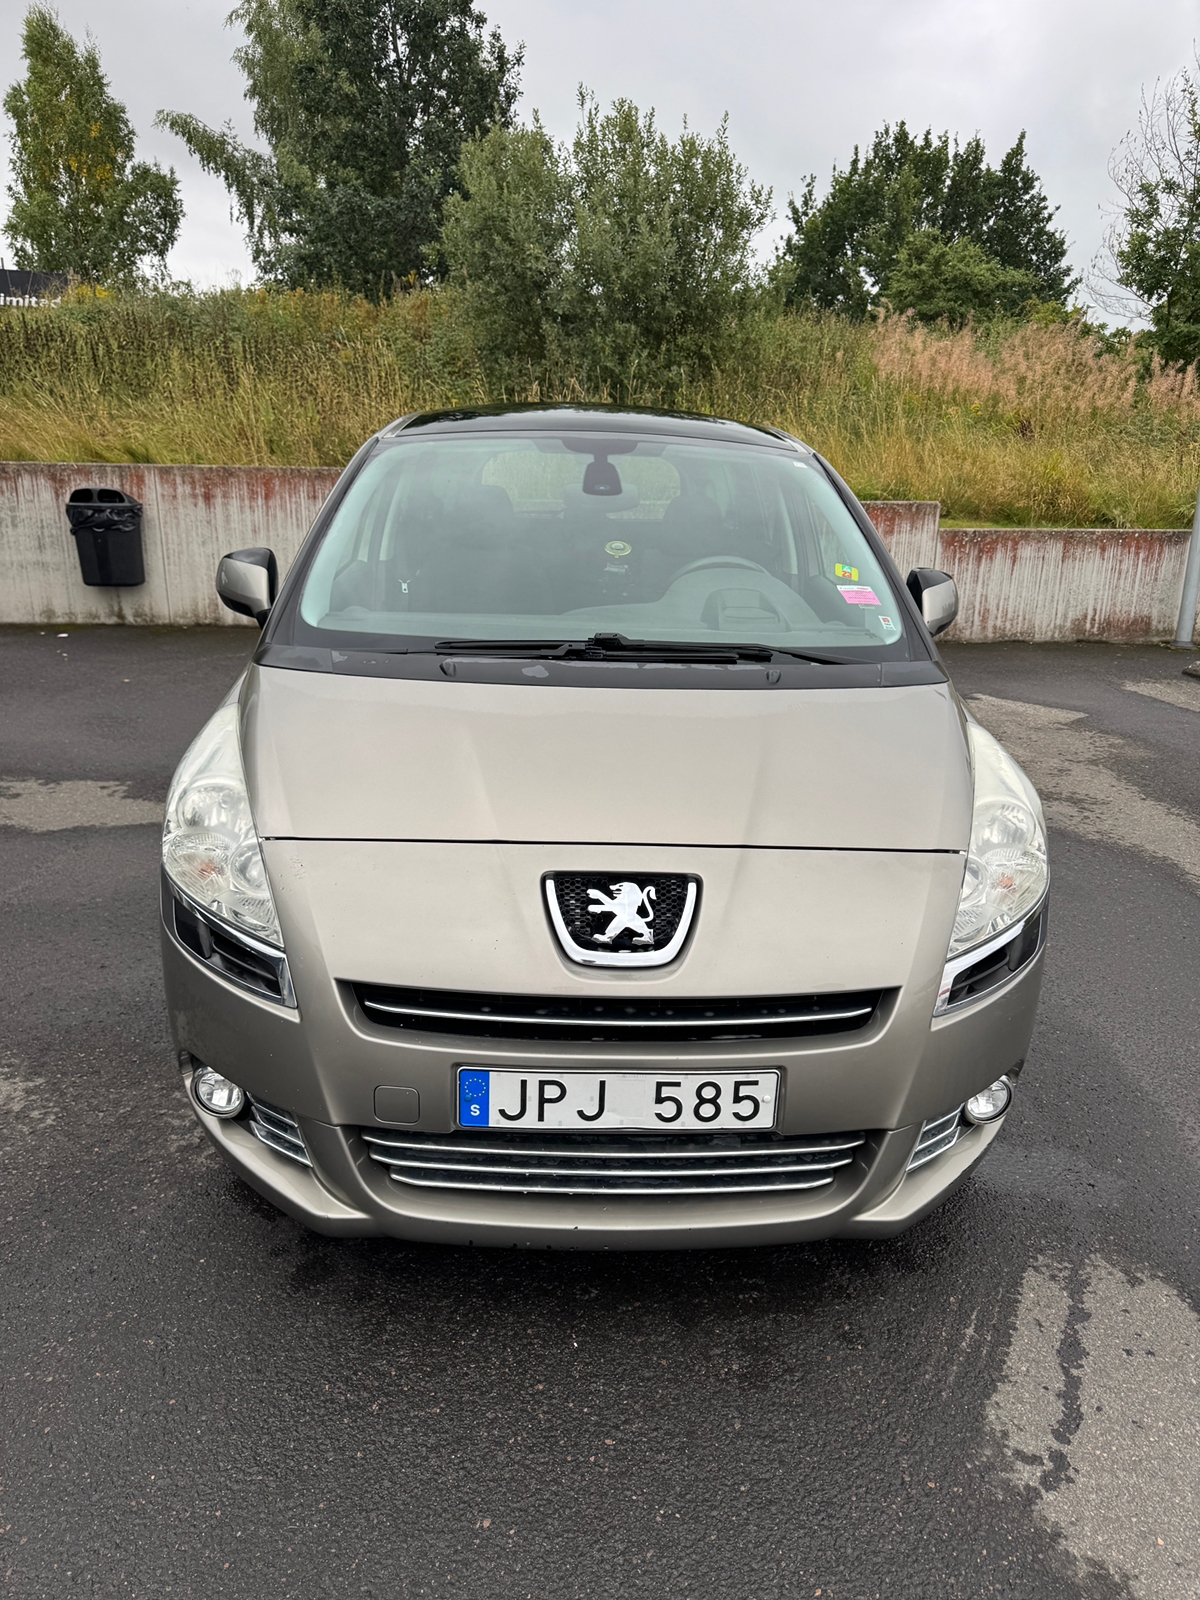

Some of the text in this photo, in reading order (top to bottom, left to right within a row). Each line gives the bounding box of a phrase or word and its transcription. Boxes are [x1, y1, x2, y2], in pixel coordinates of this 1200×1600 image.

[470, 1104, 480, 1117] S
[498, 1079, 760, 1122] JPJ 585
